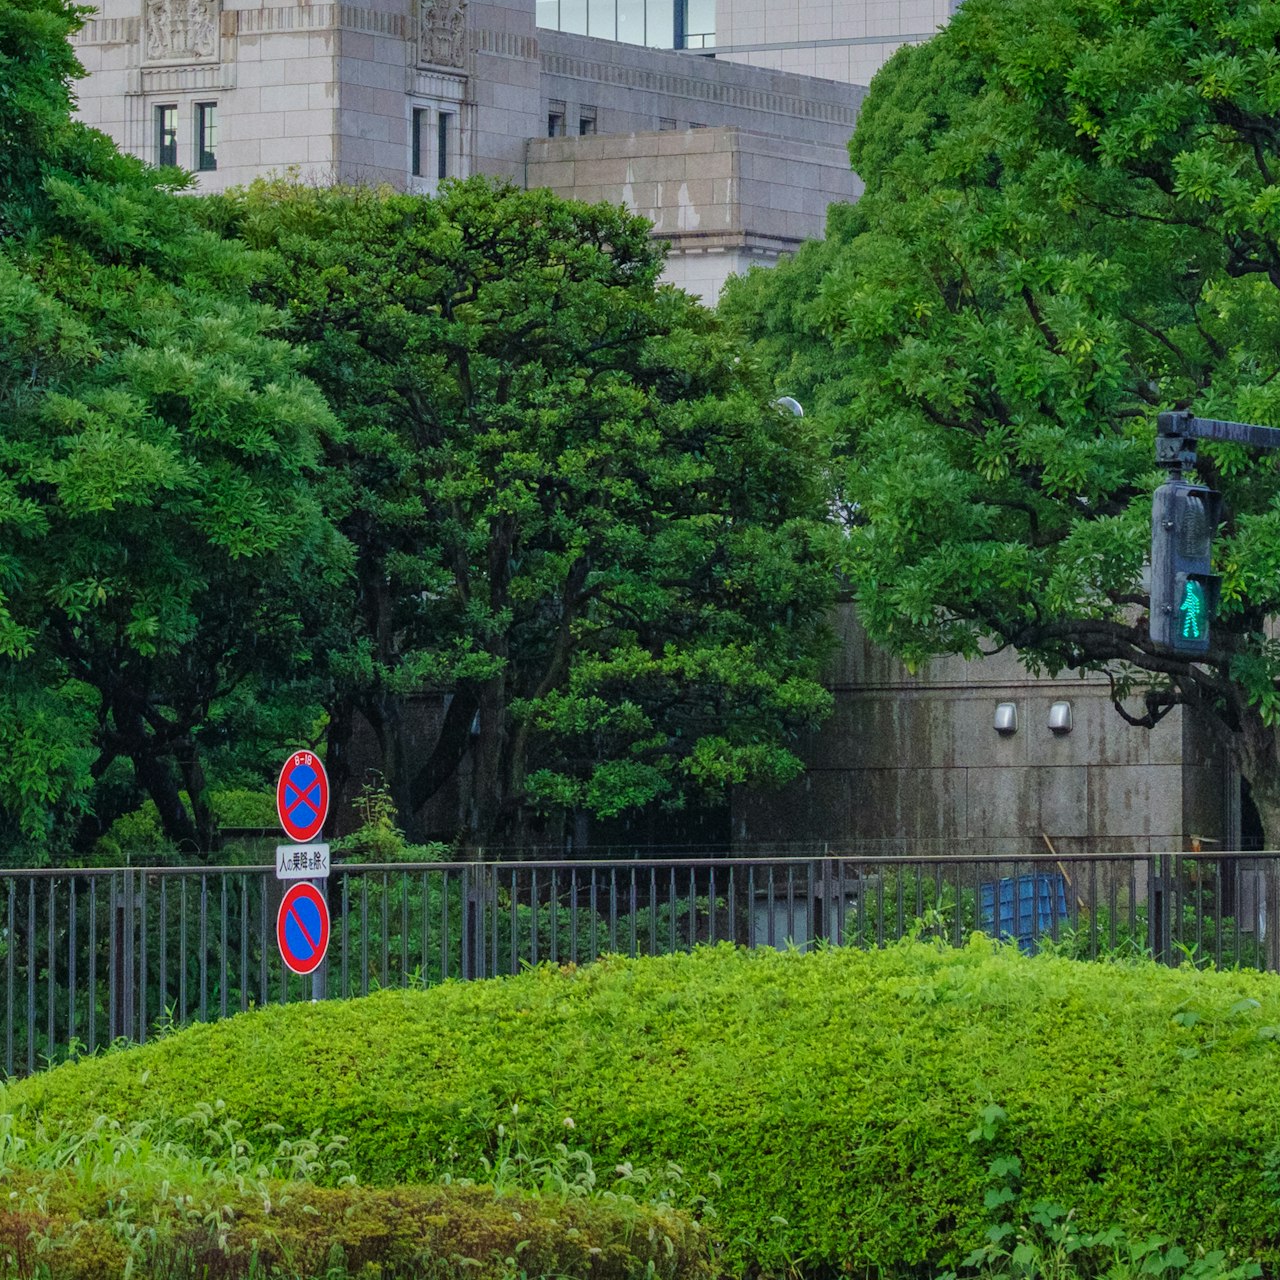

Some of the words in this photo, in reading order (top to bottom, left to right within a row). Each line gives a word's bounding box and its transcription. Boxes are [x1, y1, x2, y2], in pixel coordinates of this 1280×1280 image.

[294, 754, 313, 766] 8-18
[279, 851, 327, 872] 人の乗降を除く
